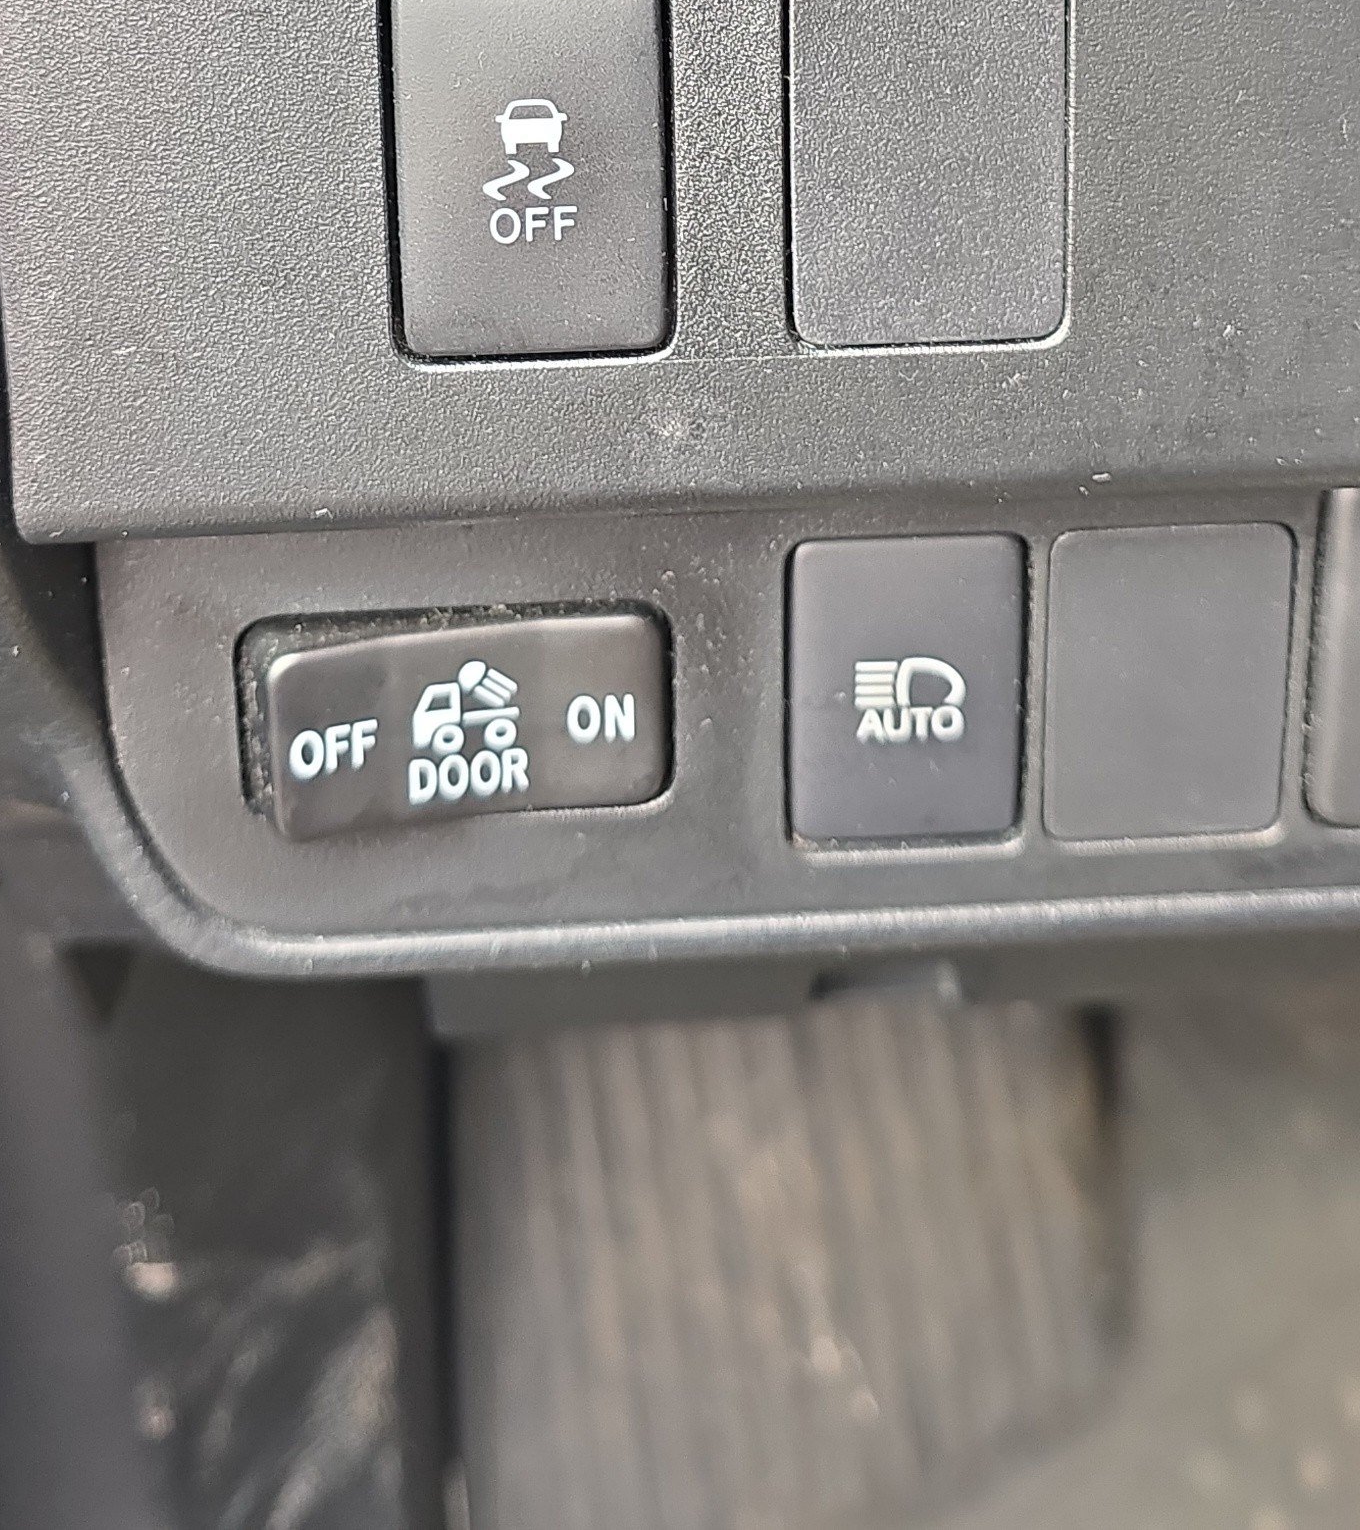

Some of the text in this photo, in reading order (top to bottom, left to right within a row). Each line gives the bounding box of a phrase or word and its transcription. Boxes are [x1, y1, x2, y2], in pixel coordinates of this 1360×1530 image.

[489, 205, 578, 244] OFF
[566, 693, 636, 743] ON
[856, 706, 965, 743] AUTO
[289, 718, 378, 780] OFF
[407, 747, 530, 805] DOOR
